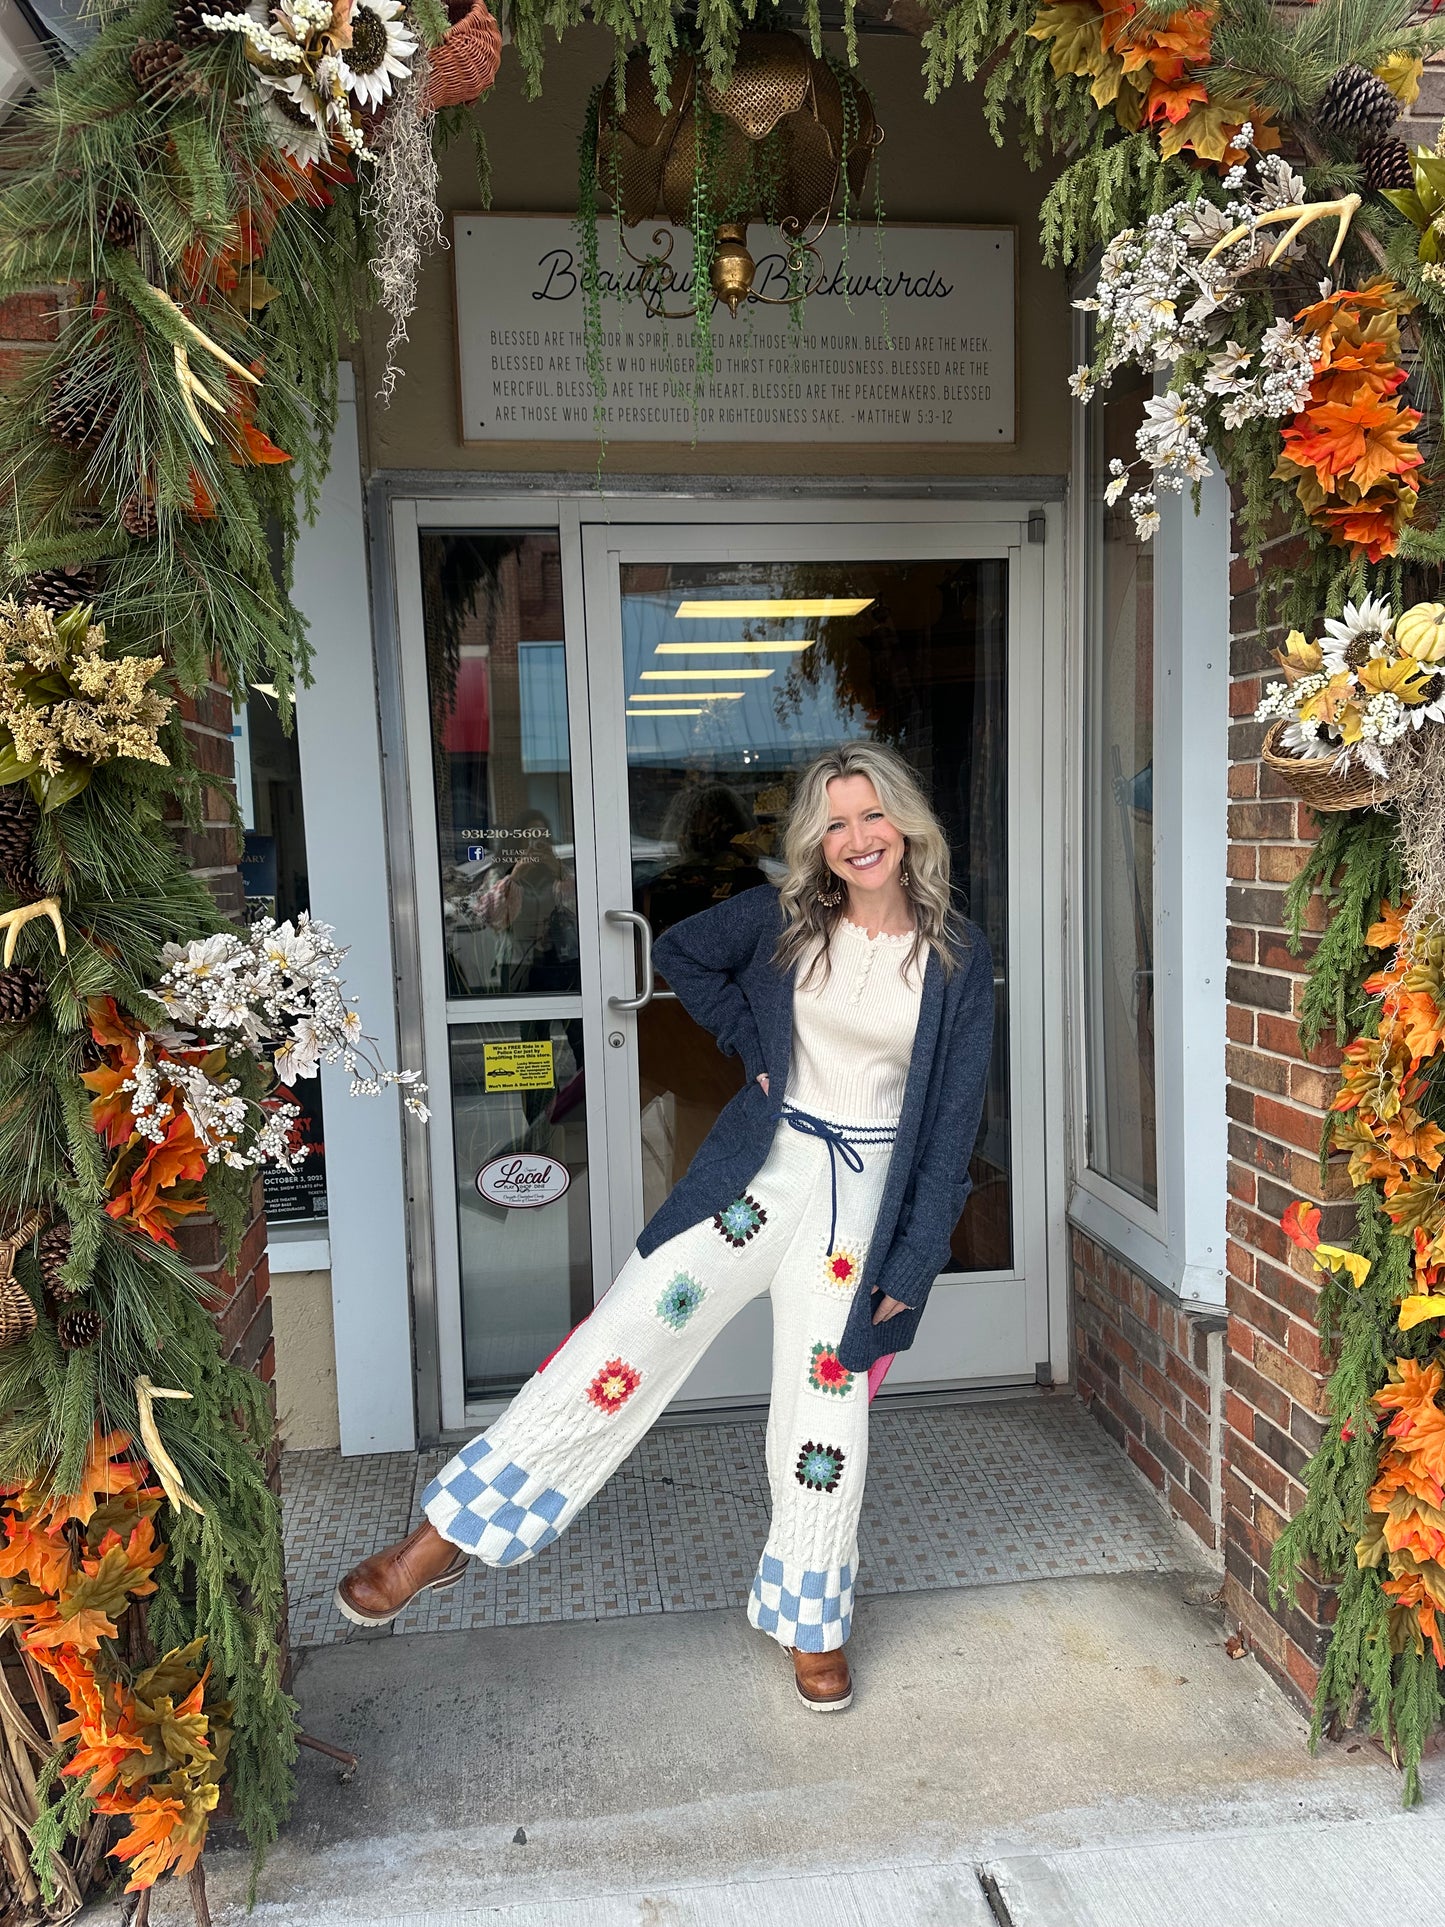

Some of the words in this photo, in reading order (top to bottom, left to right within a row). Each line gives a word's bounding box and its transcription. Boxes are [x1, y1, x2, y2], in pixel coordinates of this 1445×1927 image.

[490, 330, 540, 346] BLESSED
[544, 331, 565, 346] ARE
[625, 332, 634, 347] IN
[639, 332, 674, 348] SPIRIT.
[729, 333, 749, 349] ARE
[753, 334, 787, 349] THOSE
[821, 335, 862, 351] MOURN.
[914, 336, 935, 352] ARE
[938, 337, 957, 352] THE
[960, 337, 993, 352] MEEK.
[491, 355, 544, 371] BLESSED
[549, 356, 571, 371] ARE
[617, 357, 645, 372] WHO
[650, 357, 695, 373] HUNGER
[727, 358, 764, 374] THIRST
[769, 359, 790, 374] FOR
[794, 359, 888, 375] RIGHTEOUSNESS.
[892, 360, 940, 376] BLESSED
[944, 361, 965, 376] ARE
[969, 361, 989, 376] THE
[493, 380, 553, 397] MERCIFUL.
[612, 382, 634, 397] ARE
[638, 382, 658, 398] THE
[709, 383, 749, 399] HEART.
[752, 383, 802, 399] BLESSED
[806, 384, 827, 399] ARE
[831, 384, 851, 400] THE
[855, 384, 941, 401] PEACEMAKERS.
[943, 385, 991, 401] BLESSED
[495, 406, 517, 421] ARE
[521, 406, 557, 422] THOSE
[562, 407, 588, 422] WHO
[618, 407, 689, 423] PERSECUTED
[719, 408, 807, 424] RIGHTEOUSNESS
[812, 409, 845, 424] SAKE.
[917, 409, 953, 424] 5:3-12
[461, 828, 552, 839] 931-210-5604
[264, 1176, 299, 1185] OCTOBER
[493, 1159, 552, 1193] Local
